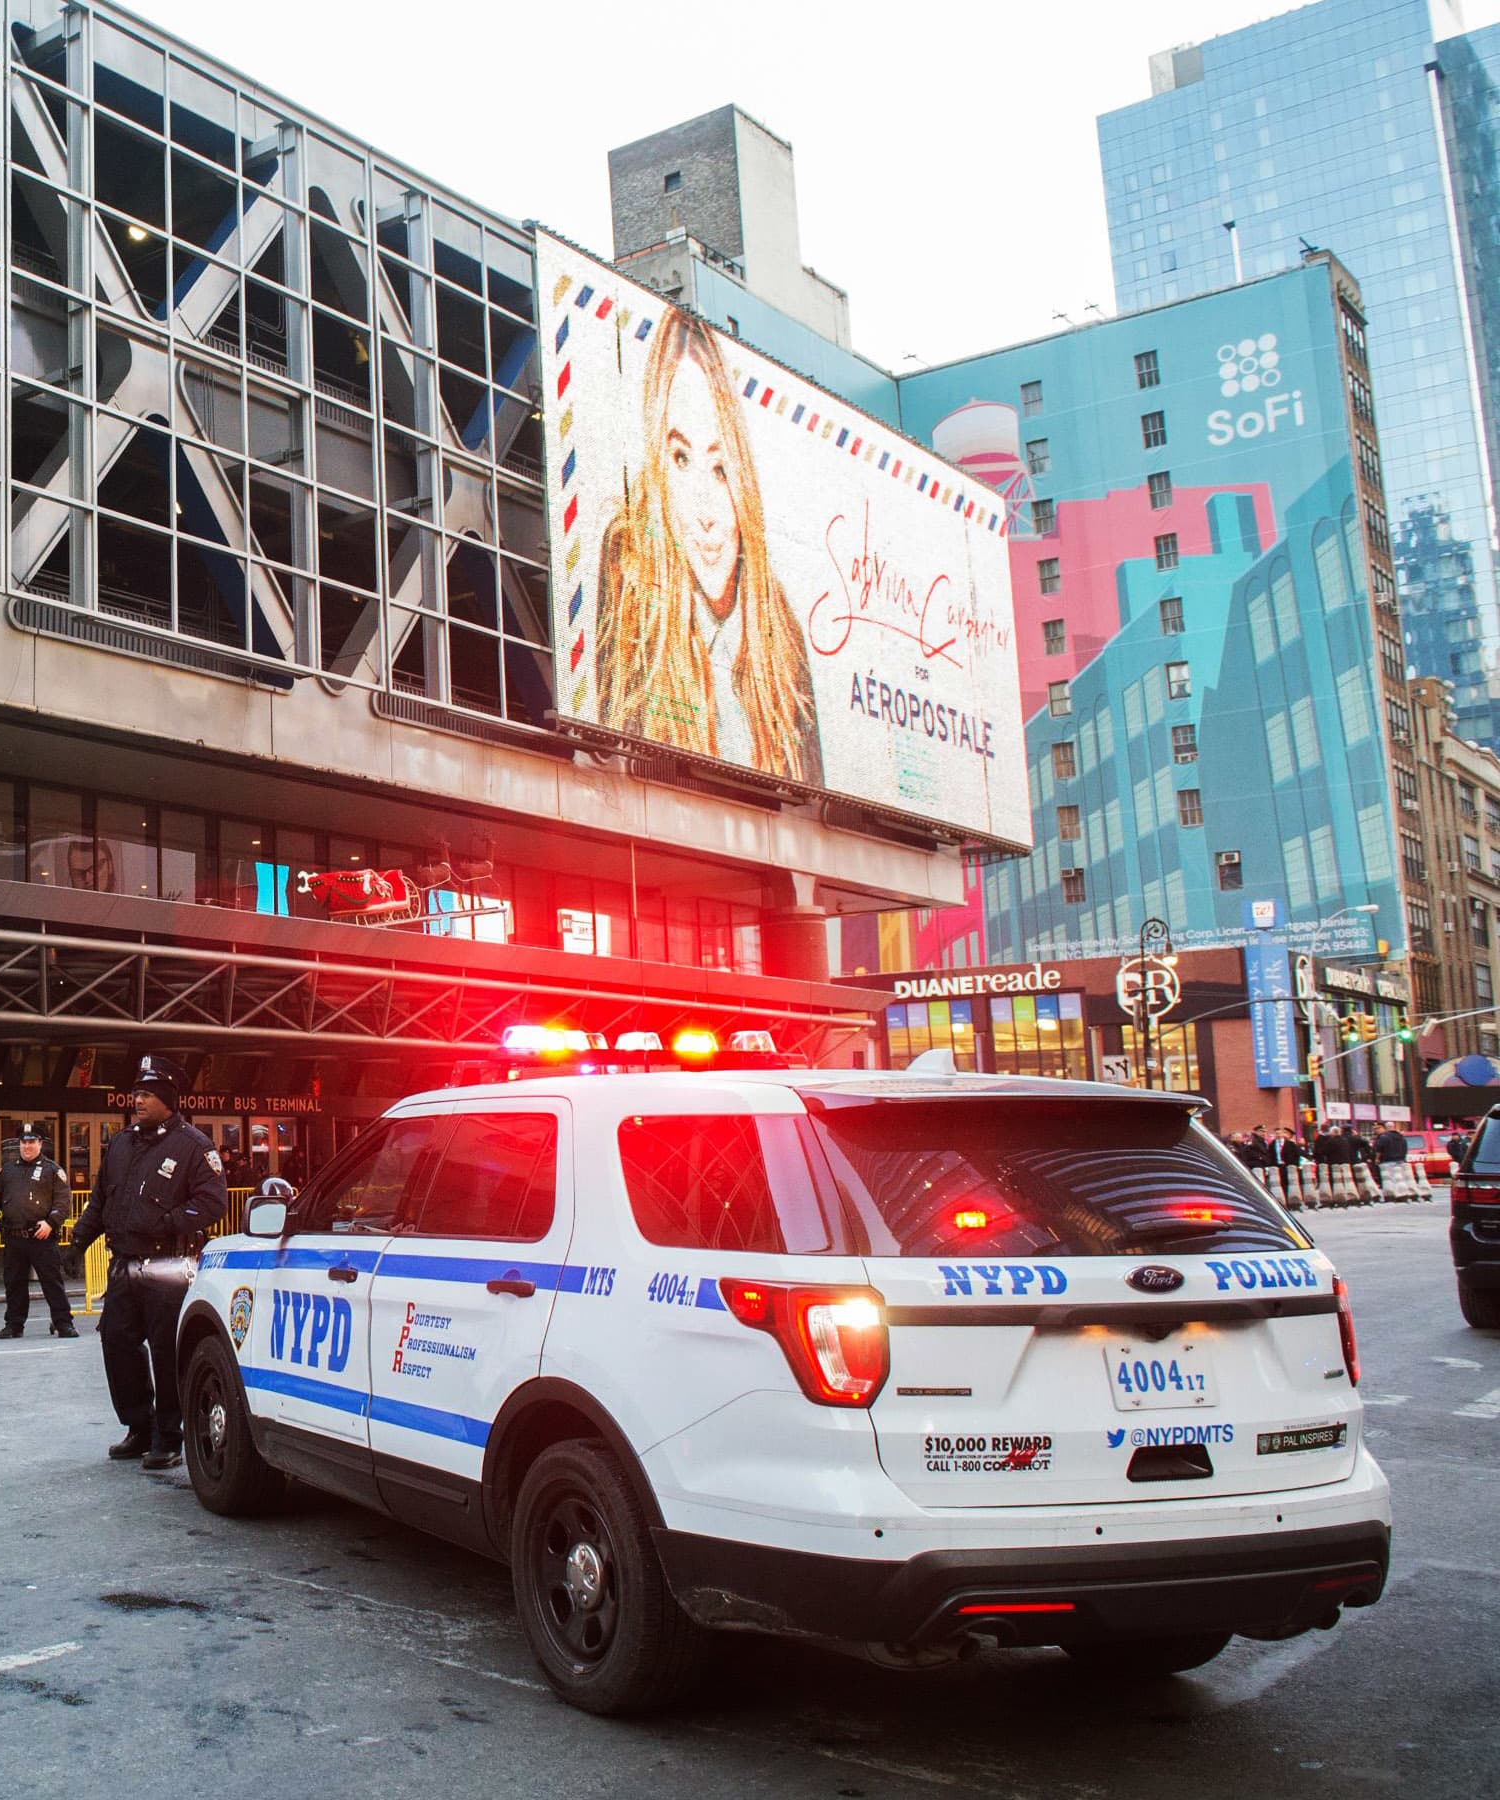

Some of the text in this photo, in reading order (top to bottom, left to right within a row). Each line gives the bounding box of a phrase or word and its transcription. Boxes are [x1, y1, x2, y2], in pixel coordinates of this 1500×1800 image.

[1206, 389, 1304, 447] SoFi
[850, 668, 995, 759] AÉROPOSTALE
[1272, 985, 1296, 1074] pharmacy
[179, 1096, 226, 1110] HORITY
[234, 1097, 257, 1111] BUS
[266, 1097, 322, 1112] TERMINAL
[584, 1266, 617, 1297] MTS
[938, 1264, 1068, 1296] NYPD
[1141, 1268, 1175, 1287] Ford
[1204, 1257, 1318, 1291] POLICE
[270, 1288, 352, 1373] NYPD
[925, 1435, 1052, 1454] $10,000 REWARD
[1131, 1424, 1234, 1447] @NYPDMTS
[1283, 1430, 1333, 1447] PAL INSPIRES
[927, 1461, 950, 1472] CALL
[954, 1461, 981, 1472] 1-800
